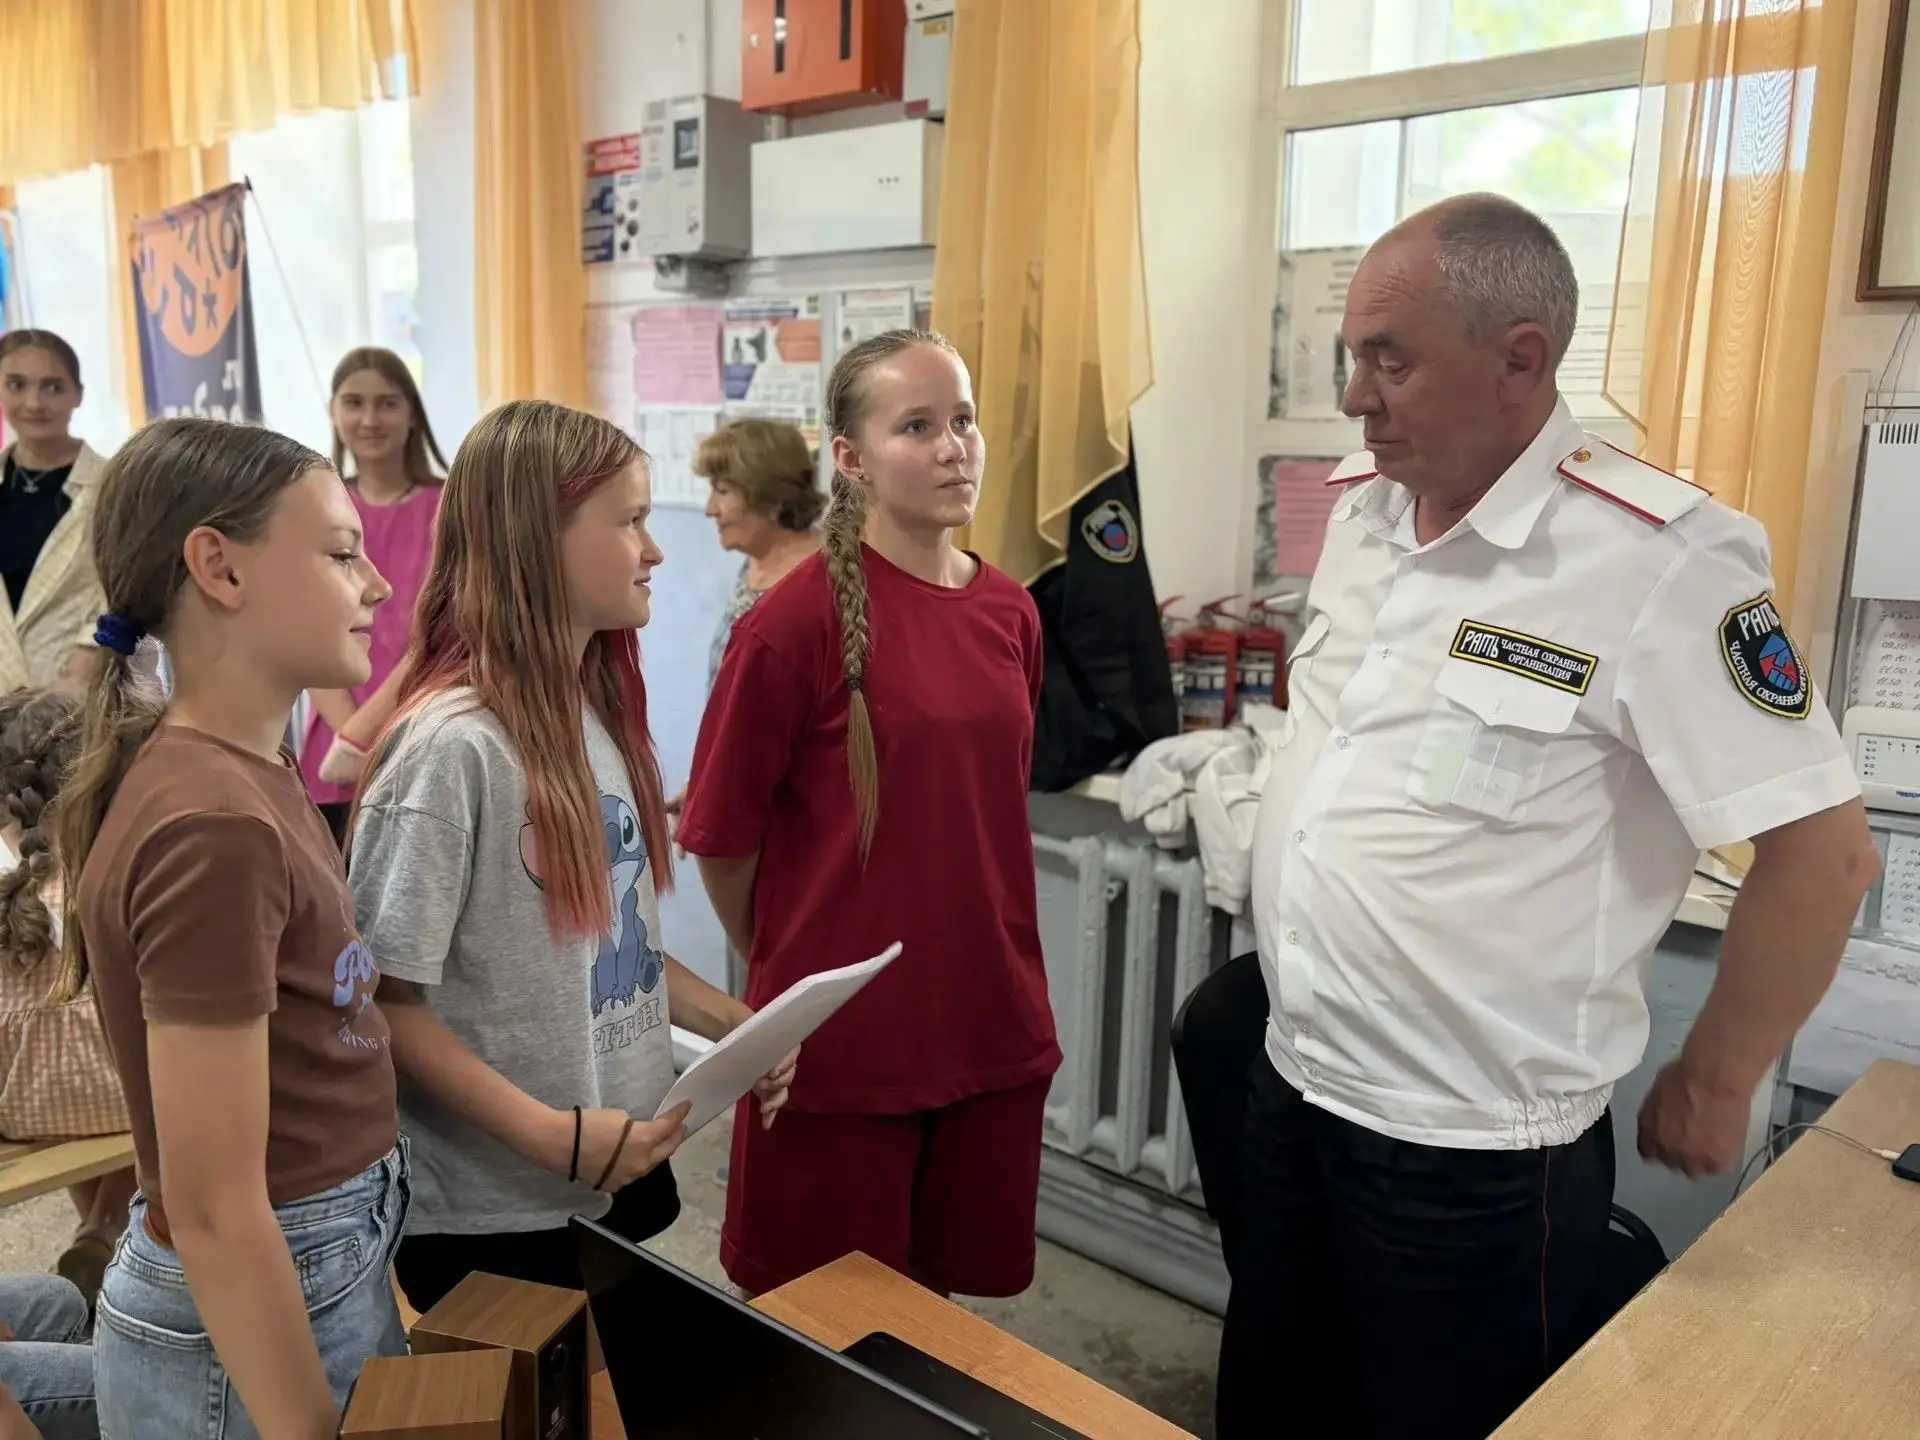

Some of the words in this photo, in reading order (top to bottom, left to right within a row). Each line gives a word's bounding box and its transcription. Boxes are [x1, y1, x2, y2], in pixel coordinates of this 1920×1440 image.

[1460, 630, 1499, 658] РАТЬ
[1501, 638, 1540, 658] ЧАСТНАЯ
[1541, 652, 1589, 674] ОХРАННАЯ
[1508, 653, 1572, 681] ОРГАНИЗАЦИЯ
[1730, 640, 1759, 692] ЧАСТНАЯ
